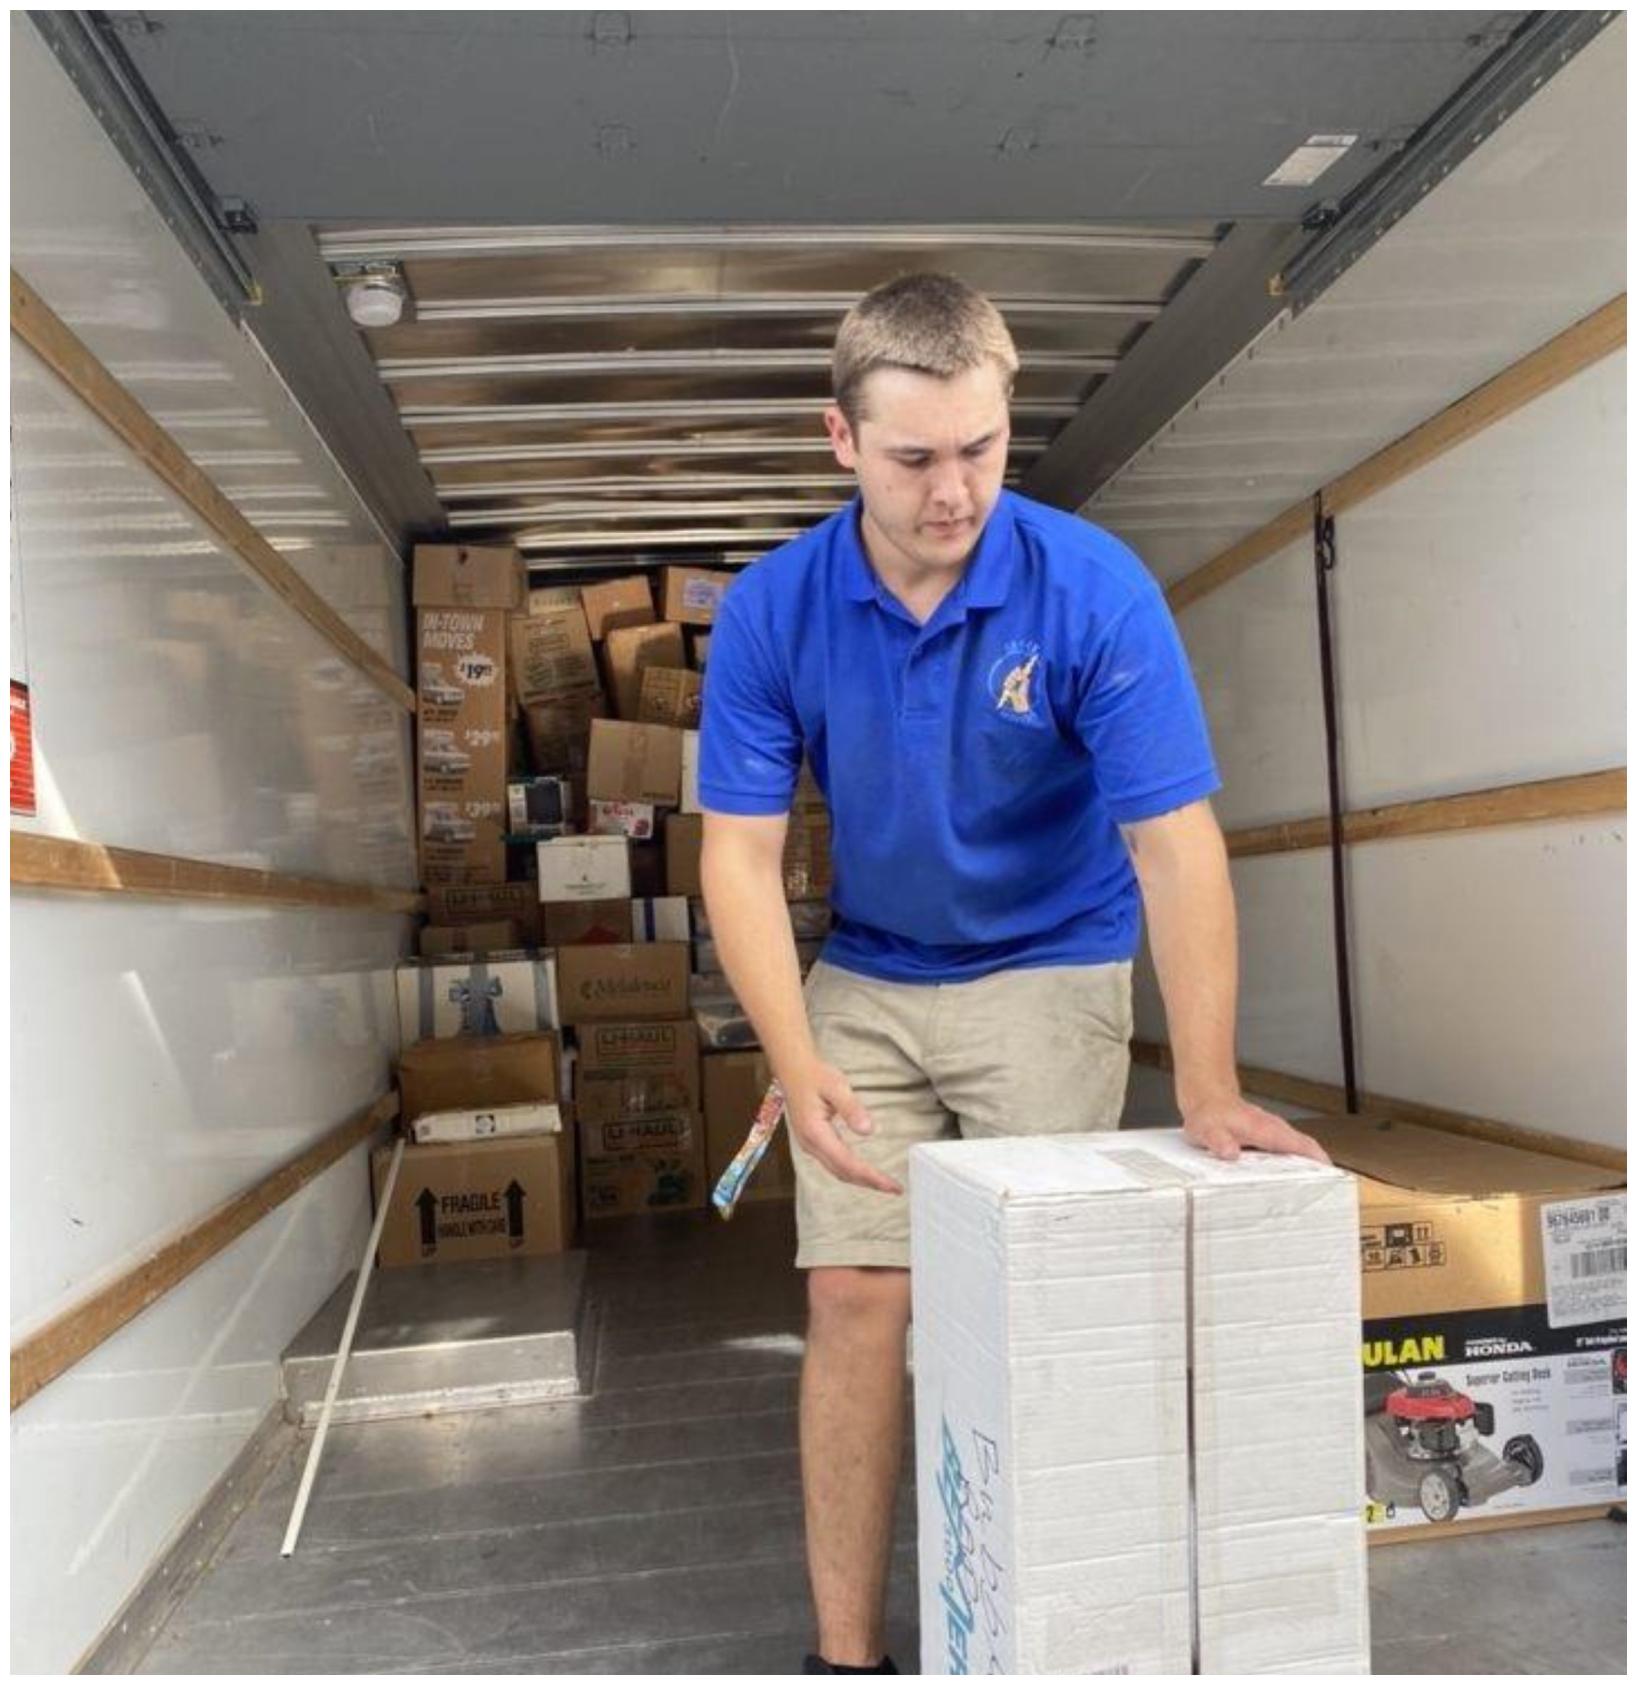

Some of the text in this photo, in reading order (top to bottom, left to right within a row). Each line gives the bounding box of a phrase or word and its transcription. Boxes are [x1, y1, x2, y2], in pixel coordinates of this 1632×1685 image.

[423, 612, 485, 632] IN-TOWN
[422, 632, 475, 651] MOVES
[441, 1191, 501, 1214] FRAGILE
[1464, 1341, 1534, 1358] HONDA
[1465, 1373, 1501, 1388] Superior
